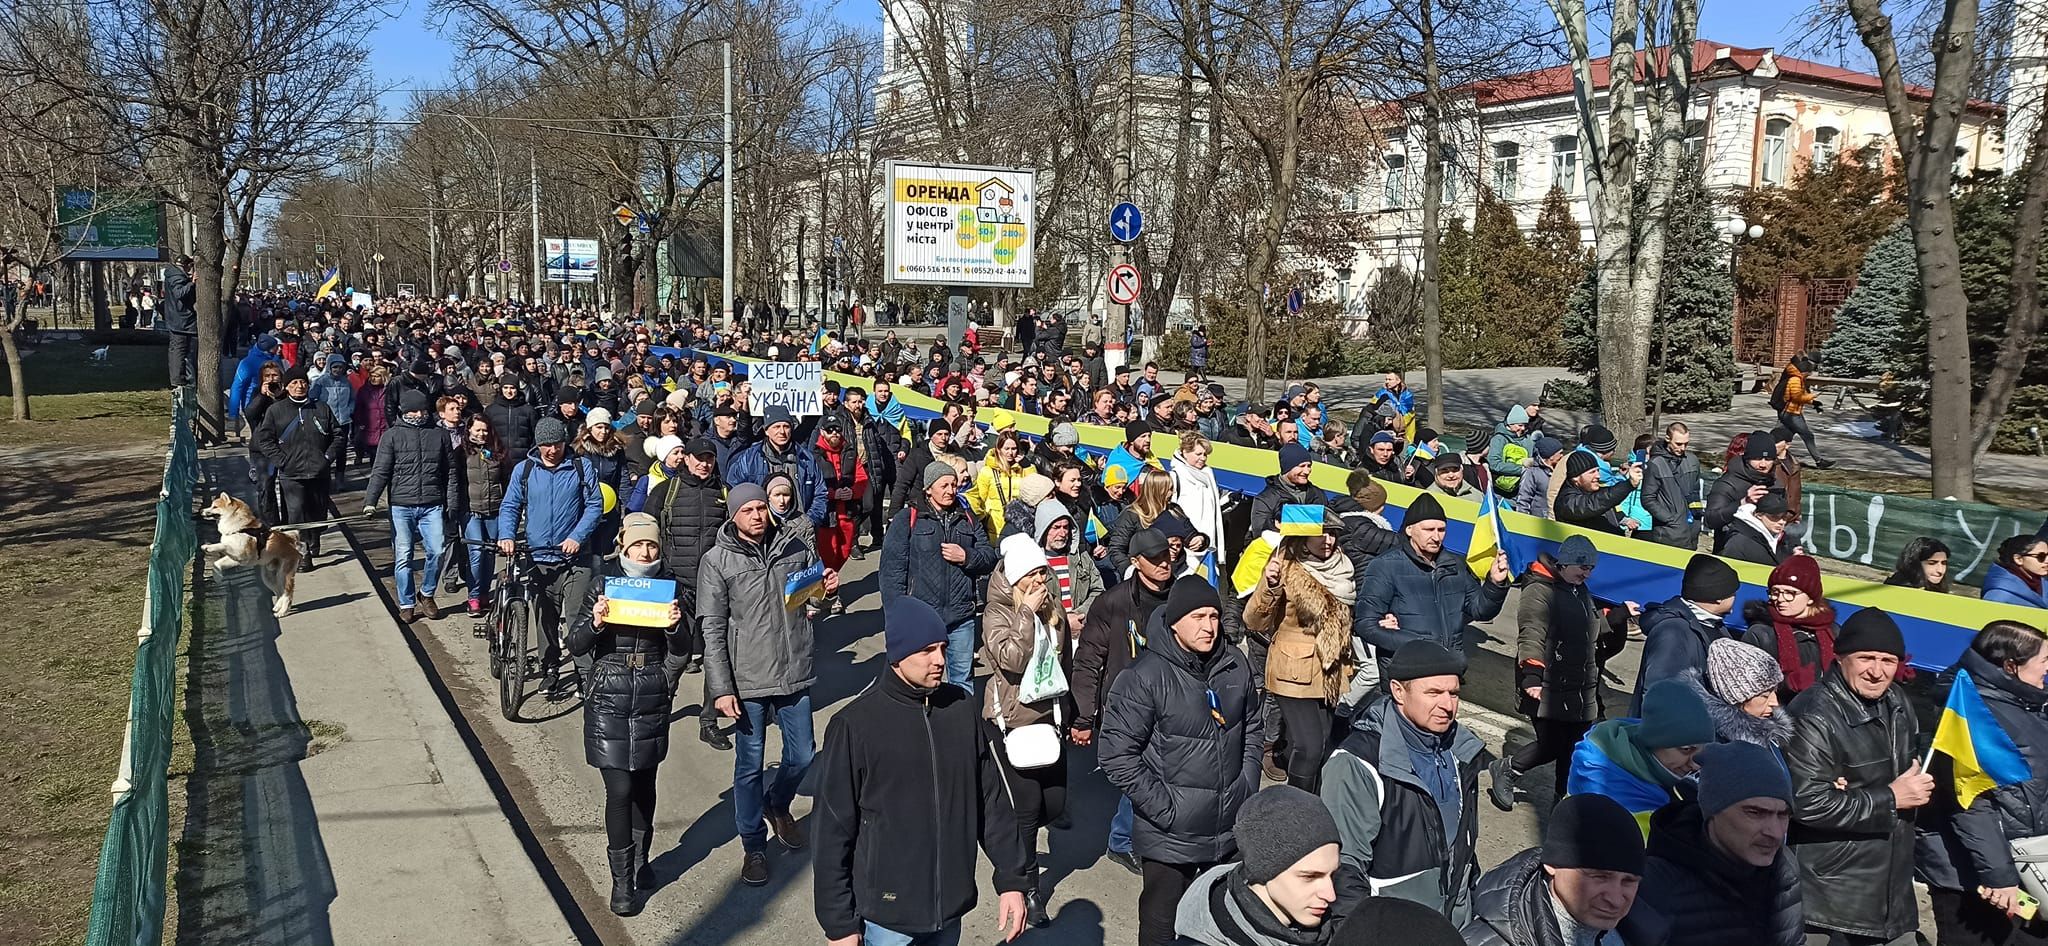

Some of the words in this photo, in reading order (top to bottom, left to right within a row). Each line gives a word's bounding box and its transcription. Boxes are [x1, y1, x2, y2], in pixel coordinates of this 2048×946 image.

[906, 184, 970, 202] ОРЕНДА
[906, 205, 948, 218] ОФІСІВ
[906, 221, 914, 232] у
[916, 220, 954, 232] центрі
[906, 233, 937, 245] міста
[906, 264, 926, 273] (066)
[927, 265, 941, 273] 516
[942, 265, 951, 273] 16
[952, 266, 961, 274] 15
[971, 266, 994, 275] (0552)
[994, 267, 1027, 275] 42-44-74
[753, 363, 821, 380] ХЕРСОН-
[775, 381, 789, 391] це
[752, 389, 819, 413] УКРАЇНА
